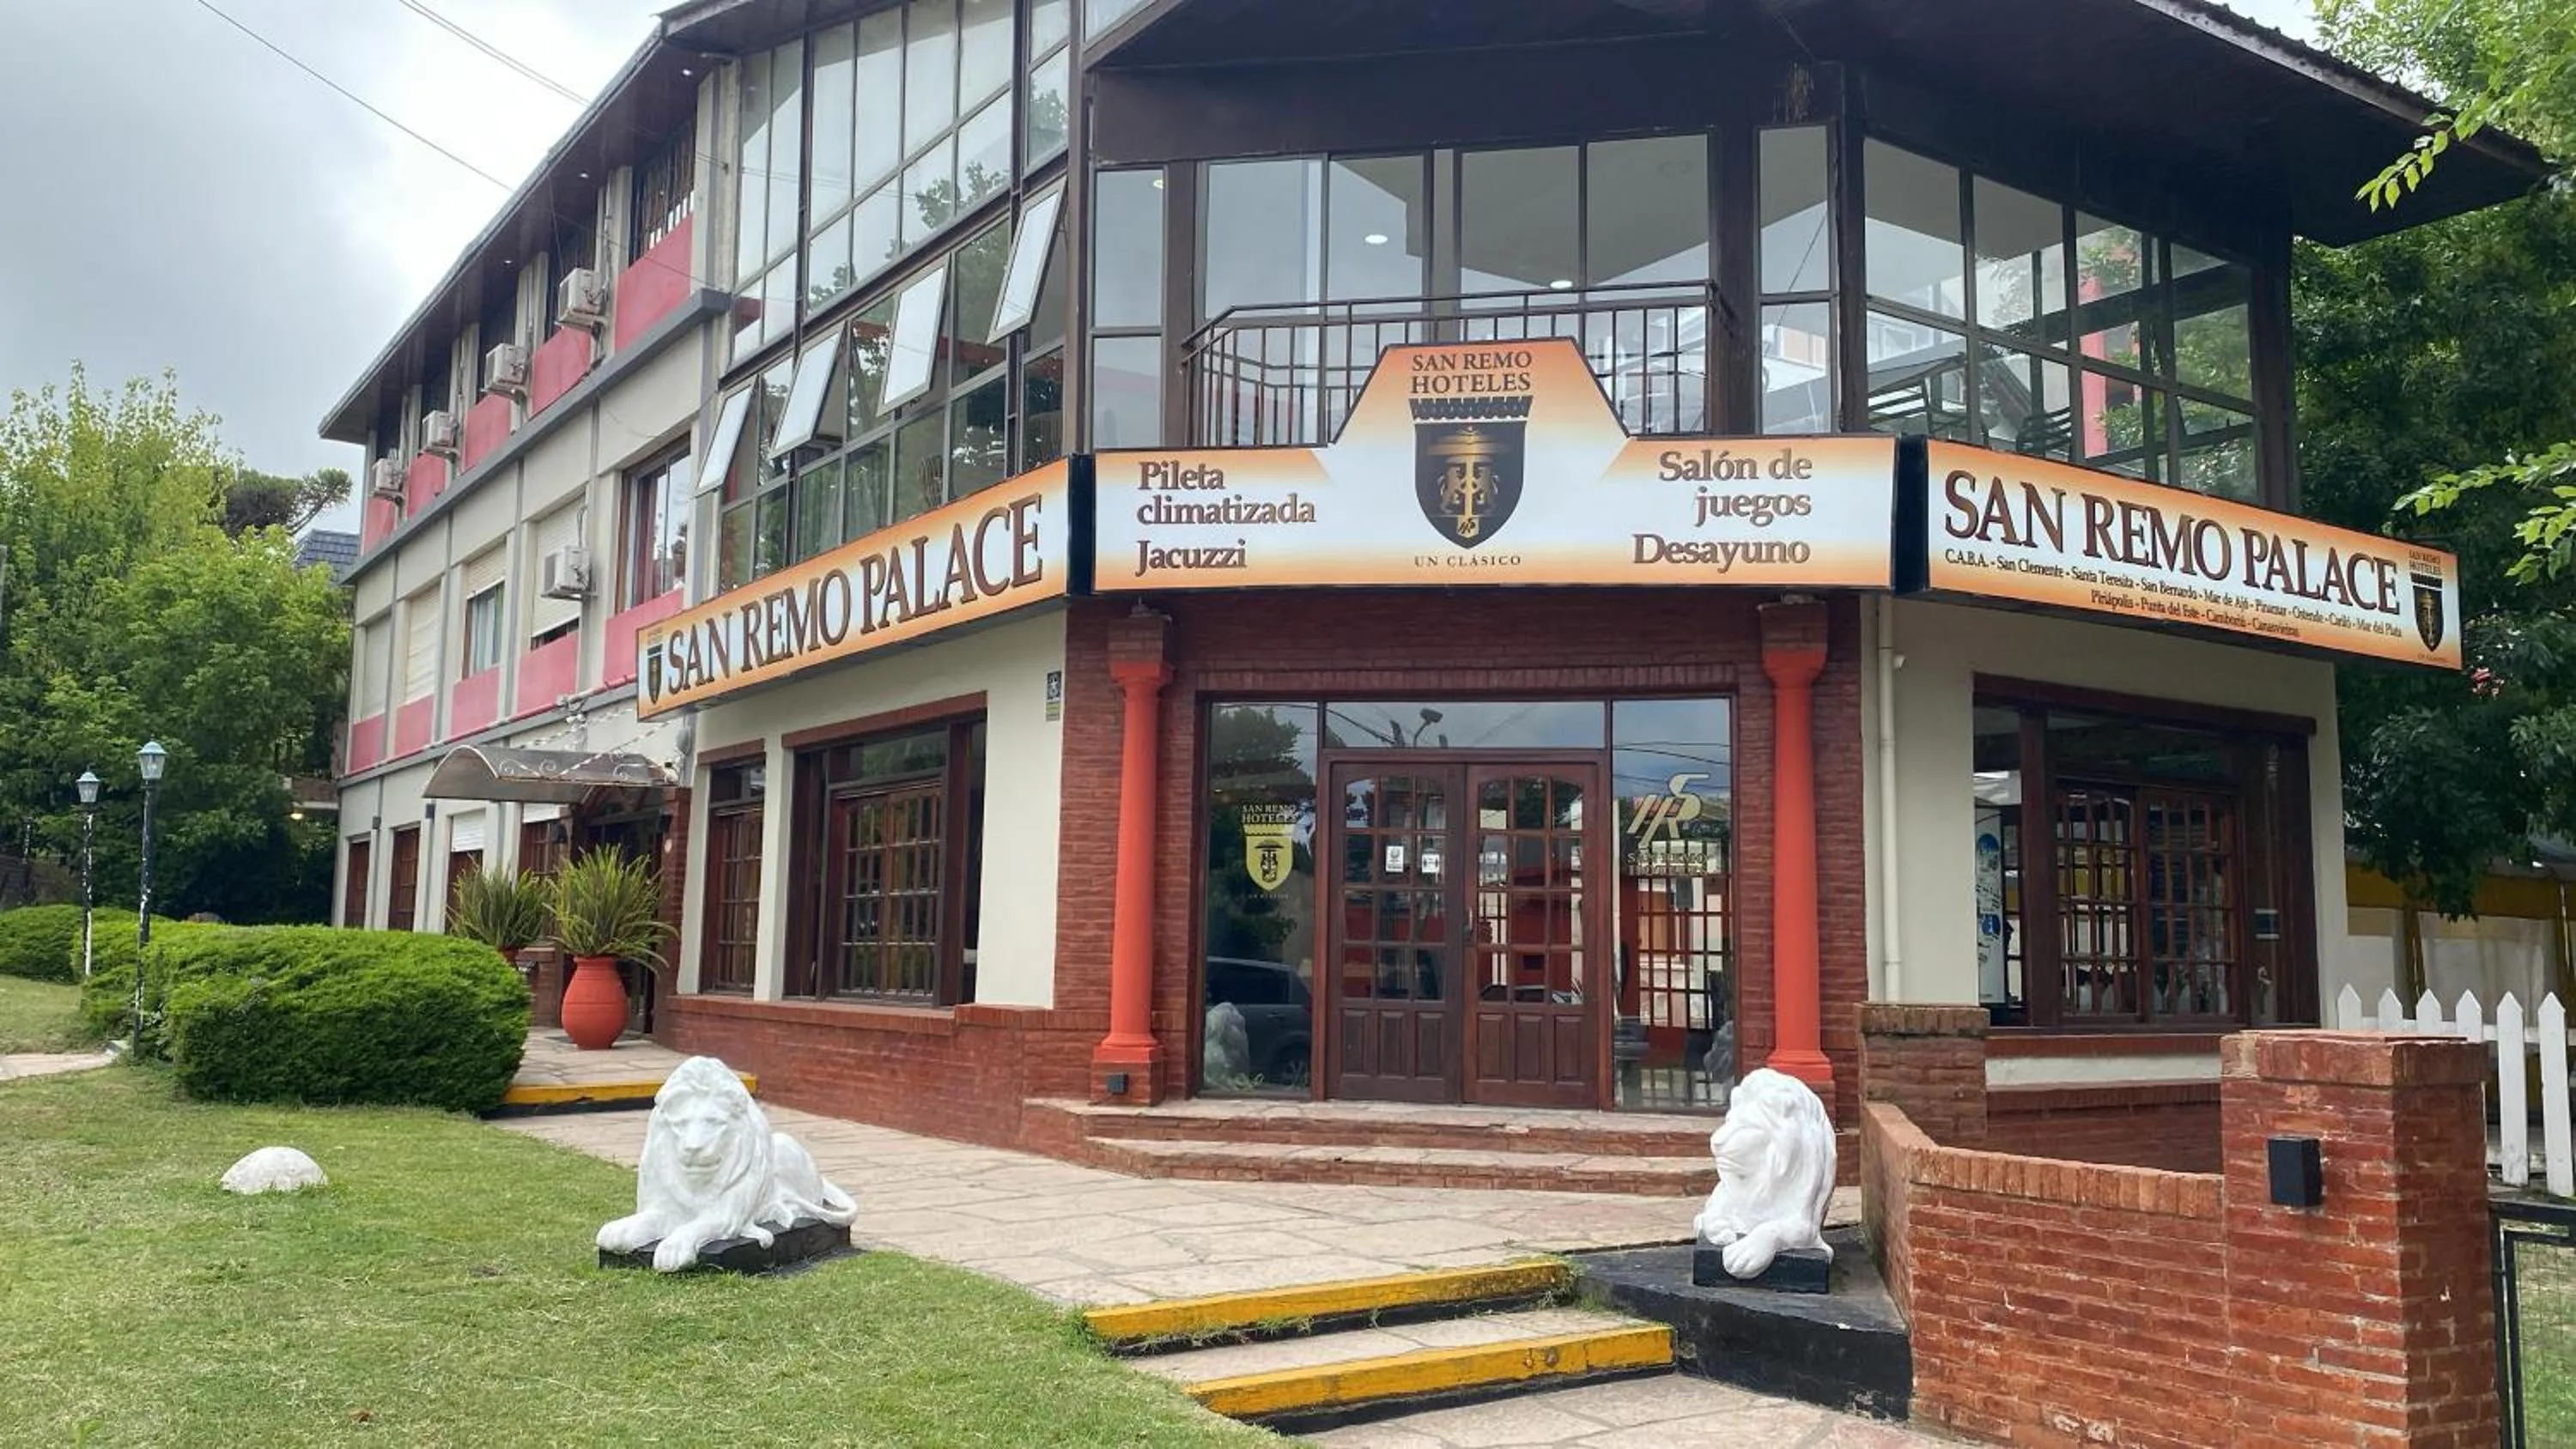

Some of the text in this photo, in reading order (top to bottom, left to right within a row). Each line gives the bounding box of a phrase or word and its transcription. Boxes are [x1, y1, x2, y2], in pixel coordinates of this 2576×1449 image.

[1412, 350, 1533, 372] SAN REMO
[1411, 372, 1531, 394] HOTELES
[1137, 459, 1226, 490] Pileta
[1658, 447, 1814, 481] Salón de
[1136, 493, 1316, 524] climatizada
[1694, 485, 1812, 528] juegos
[1134, 538, 1248, 577] Jacuzzi
[1631, 532, 1811, 574] Desayuno
[1945, 469, 2400, 615] SAN REMO PALACE
[1413, 555, 1439, 567] UN
[1944, 548, 1990, 567] C.A.B.A.
[1996, 555, 2016, 573] San
[2018, 558, 2064, 579] Clemente
[2071, 566, 2098, 584] Santa
[2098, 570, 2134, 590] Teresita
[2141, 577, 2158, 593] San
[2160, 579, 2197, 600] Bernardo
[2203, 588, 2221, 603] Mar
[668, 492, 1043, 694] SAN REMO PALACE
[2141, 597, 2166, 614] Punta
[2166, 601, 2180, 615] del
[1241, 803, 1297, 814] SAN REMO
